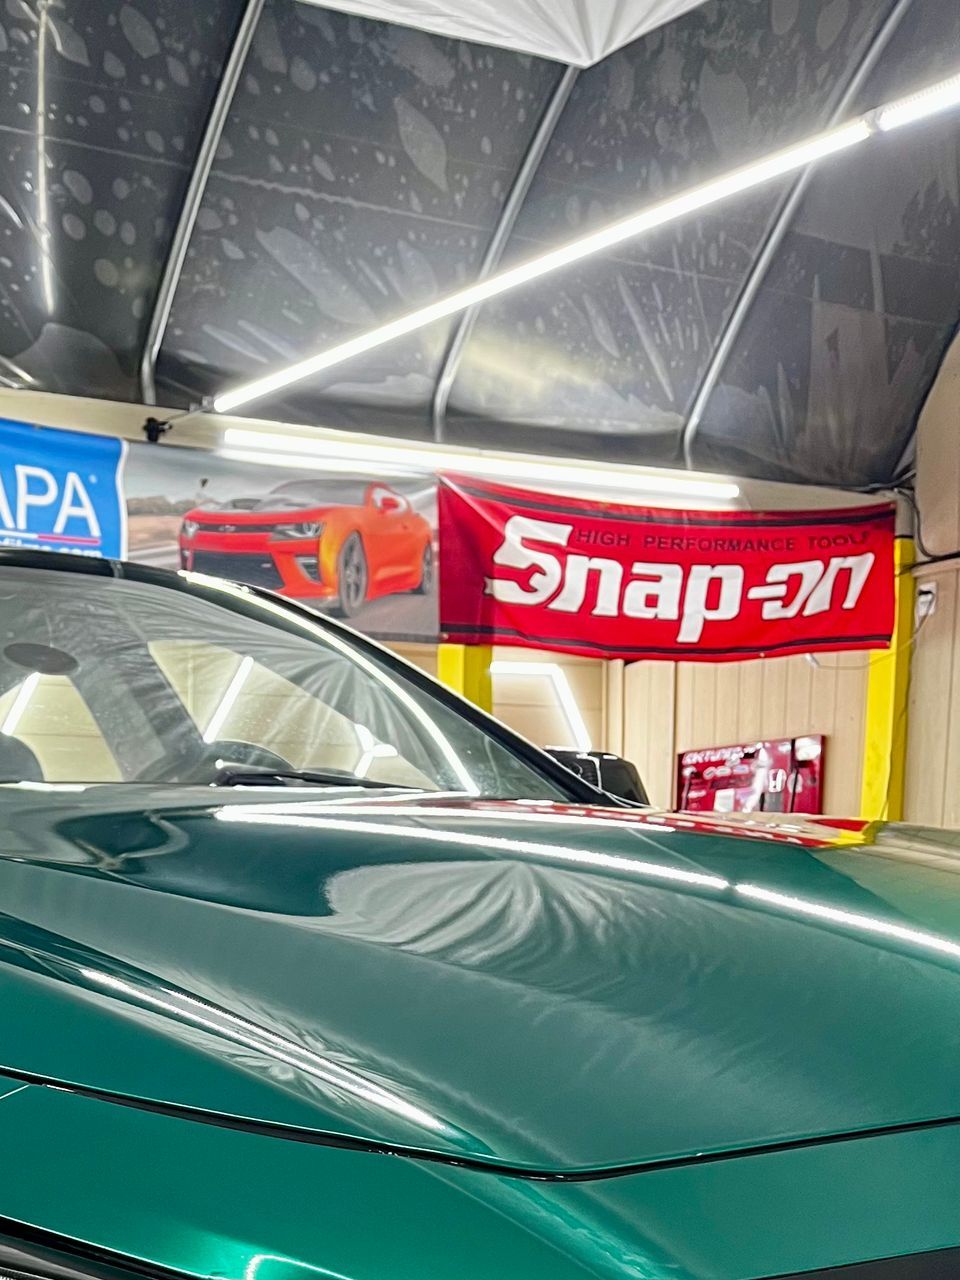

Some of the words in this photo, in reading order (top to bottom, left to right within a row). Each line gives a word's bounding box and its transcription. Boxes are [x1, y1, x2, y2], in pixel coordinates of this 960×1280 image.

[483, 514, 876, 643] Snap-on
[575, 529, 631, 548] HIGH
[642, 535, 797, 552] PERFORMANCE
